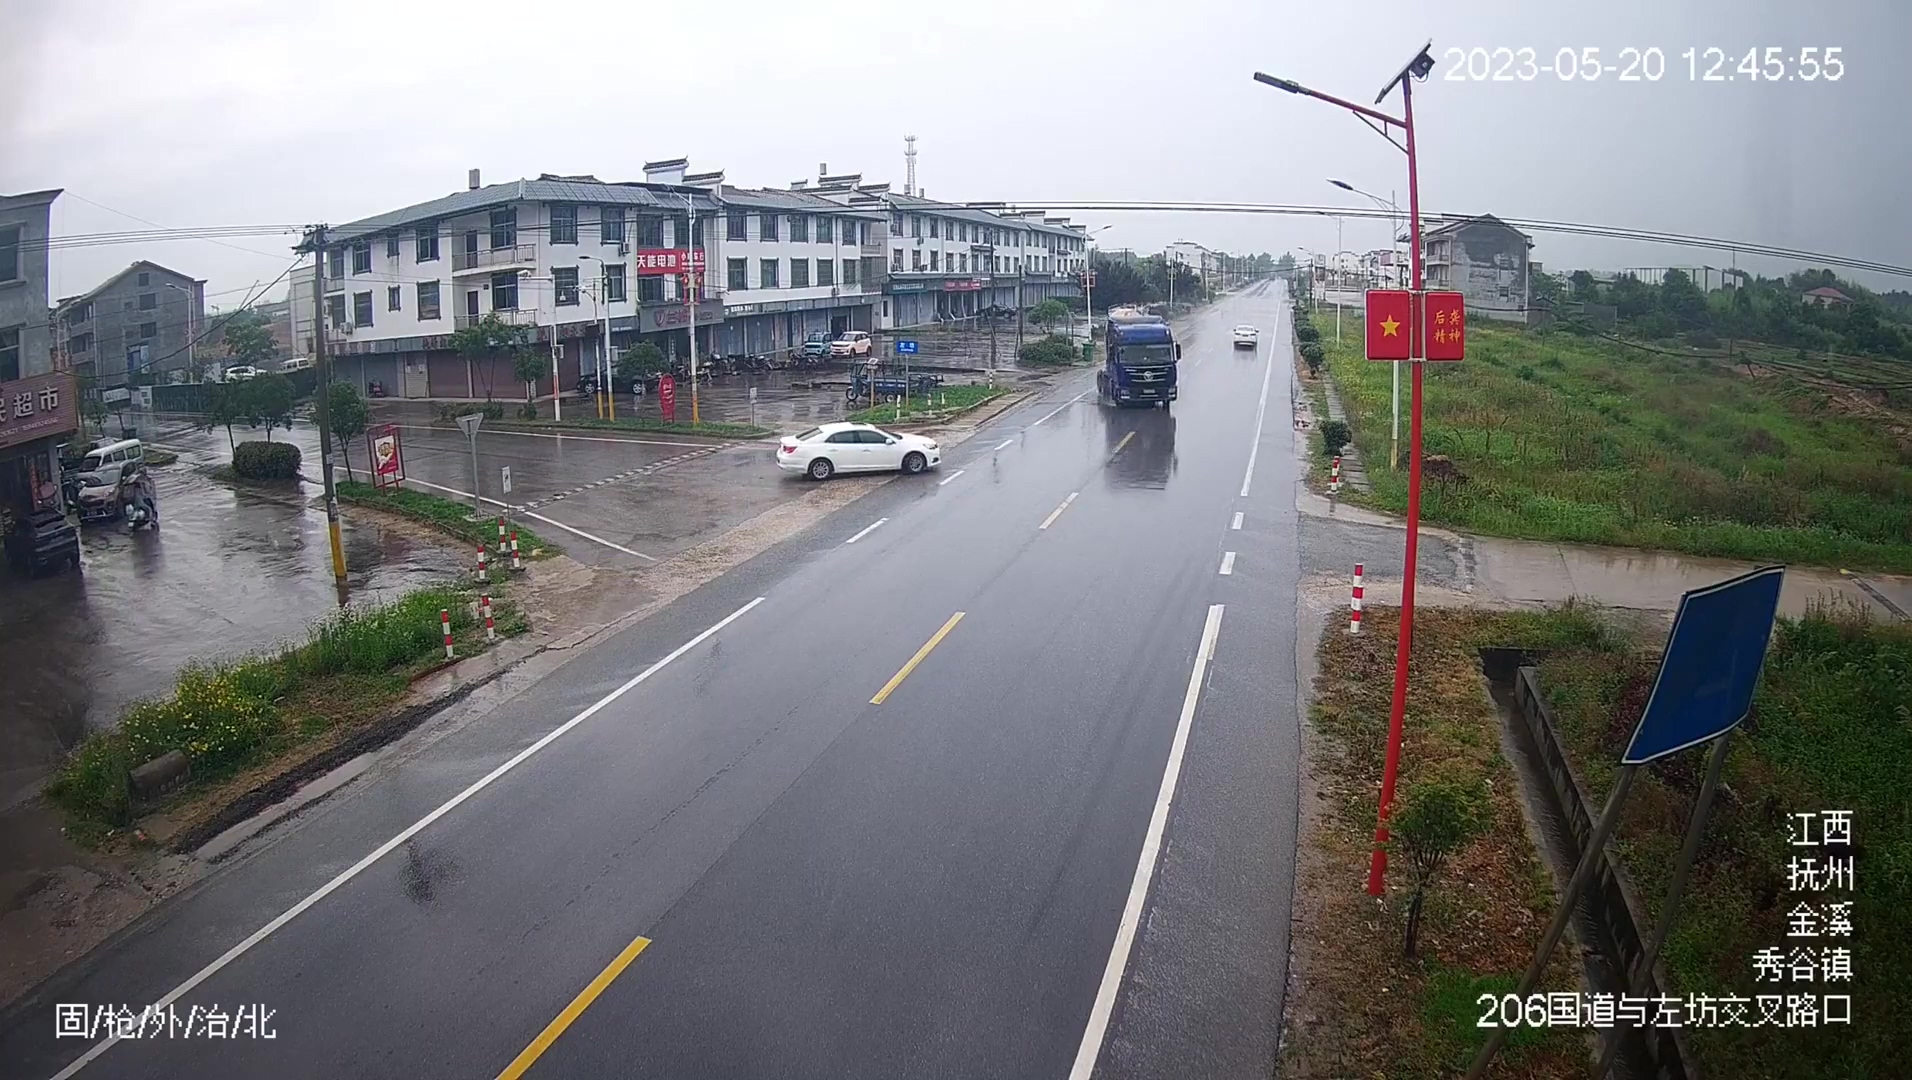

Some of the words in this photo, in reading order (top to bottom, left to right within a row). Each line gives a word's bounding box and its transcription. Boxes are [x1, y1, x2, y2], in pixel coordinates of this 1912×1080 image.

[637, 254, 676, 268] 天能电池
[1432, 328, 1461, 344] 精神
